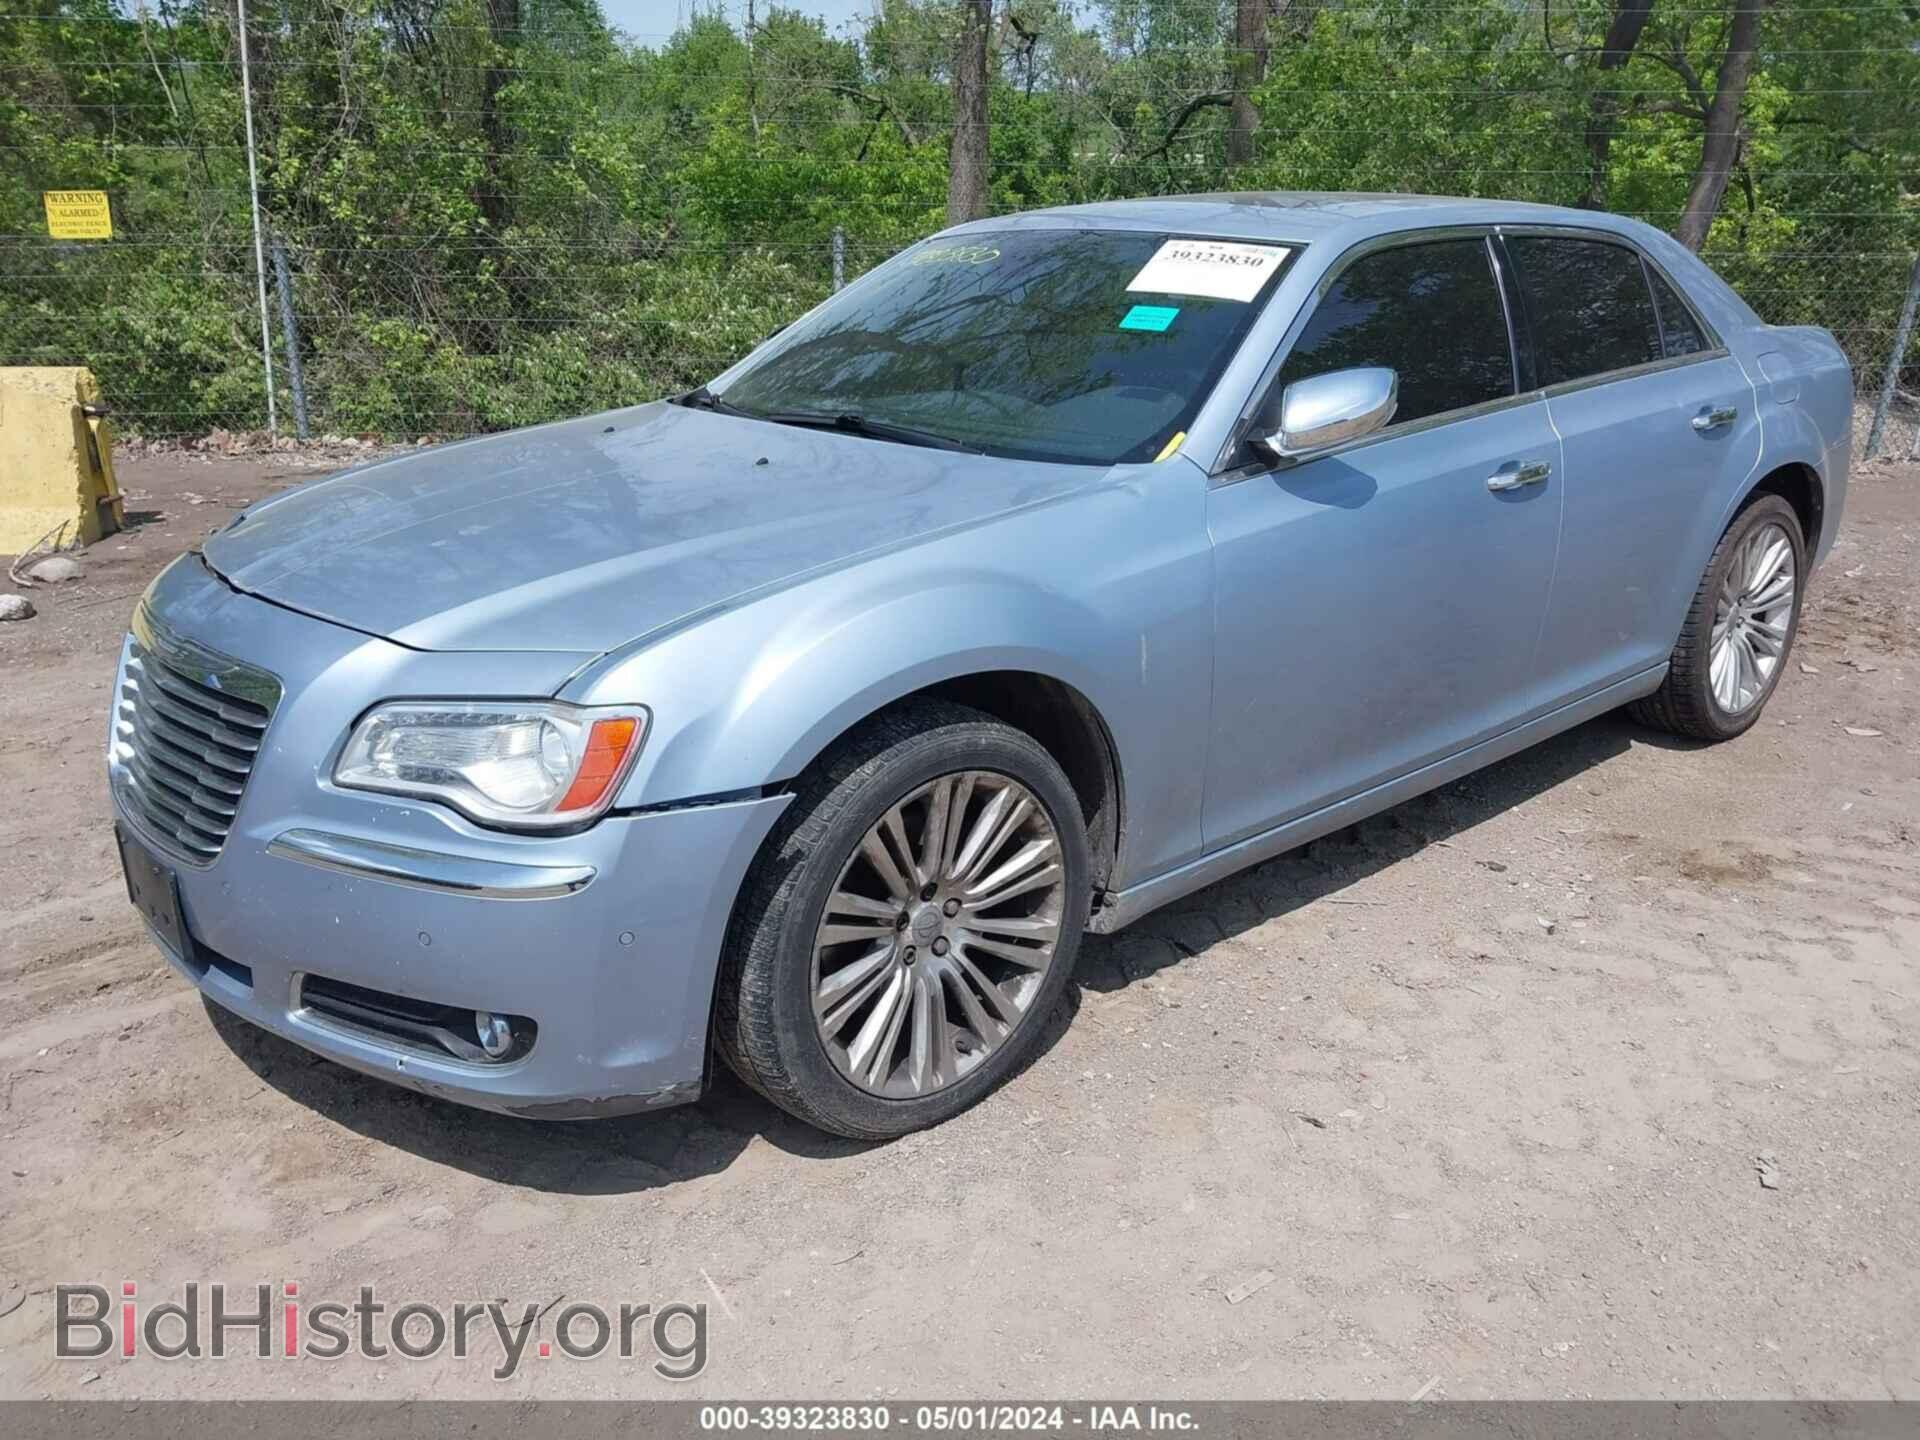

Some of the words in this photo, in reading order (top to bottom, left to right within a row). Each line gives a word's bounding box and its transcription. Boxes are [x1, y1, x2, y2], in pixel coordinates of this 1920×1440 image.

[47, 192, 104, 203] WARNING
[59, 208, 99, 217] ALARMED
[1170, 249, 1264, 268] 39323830
